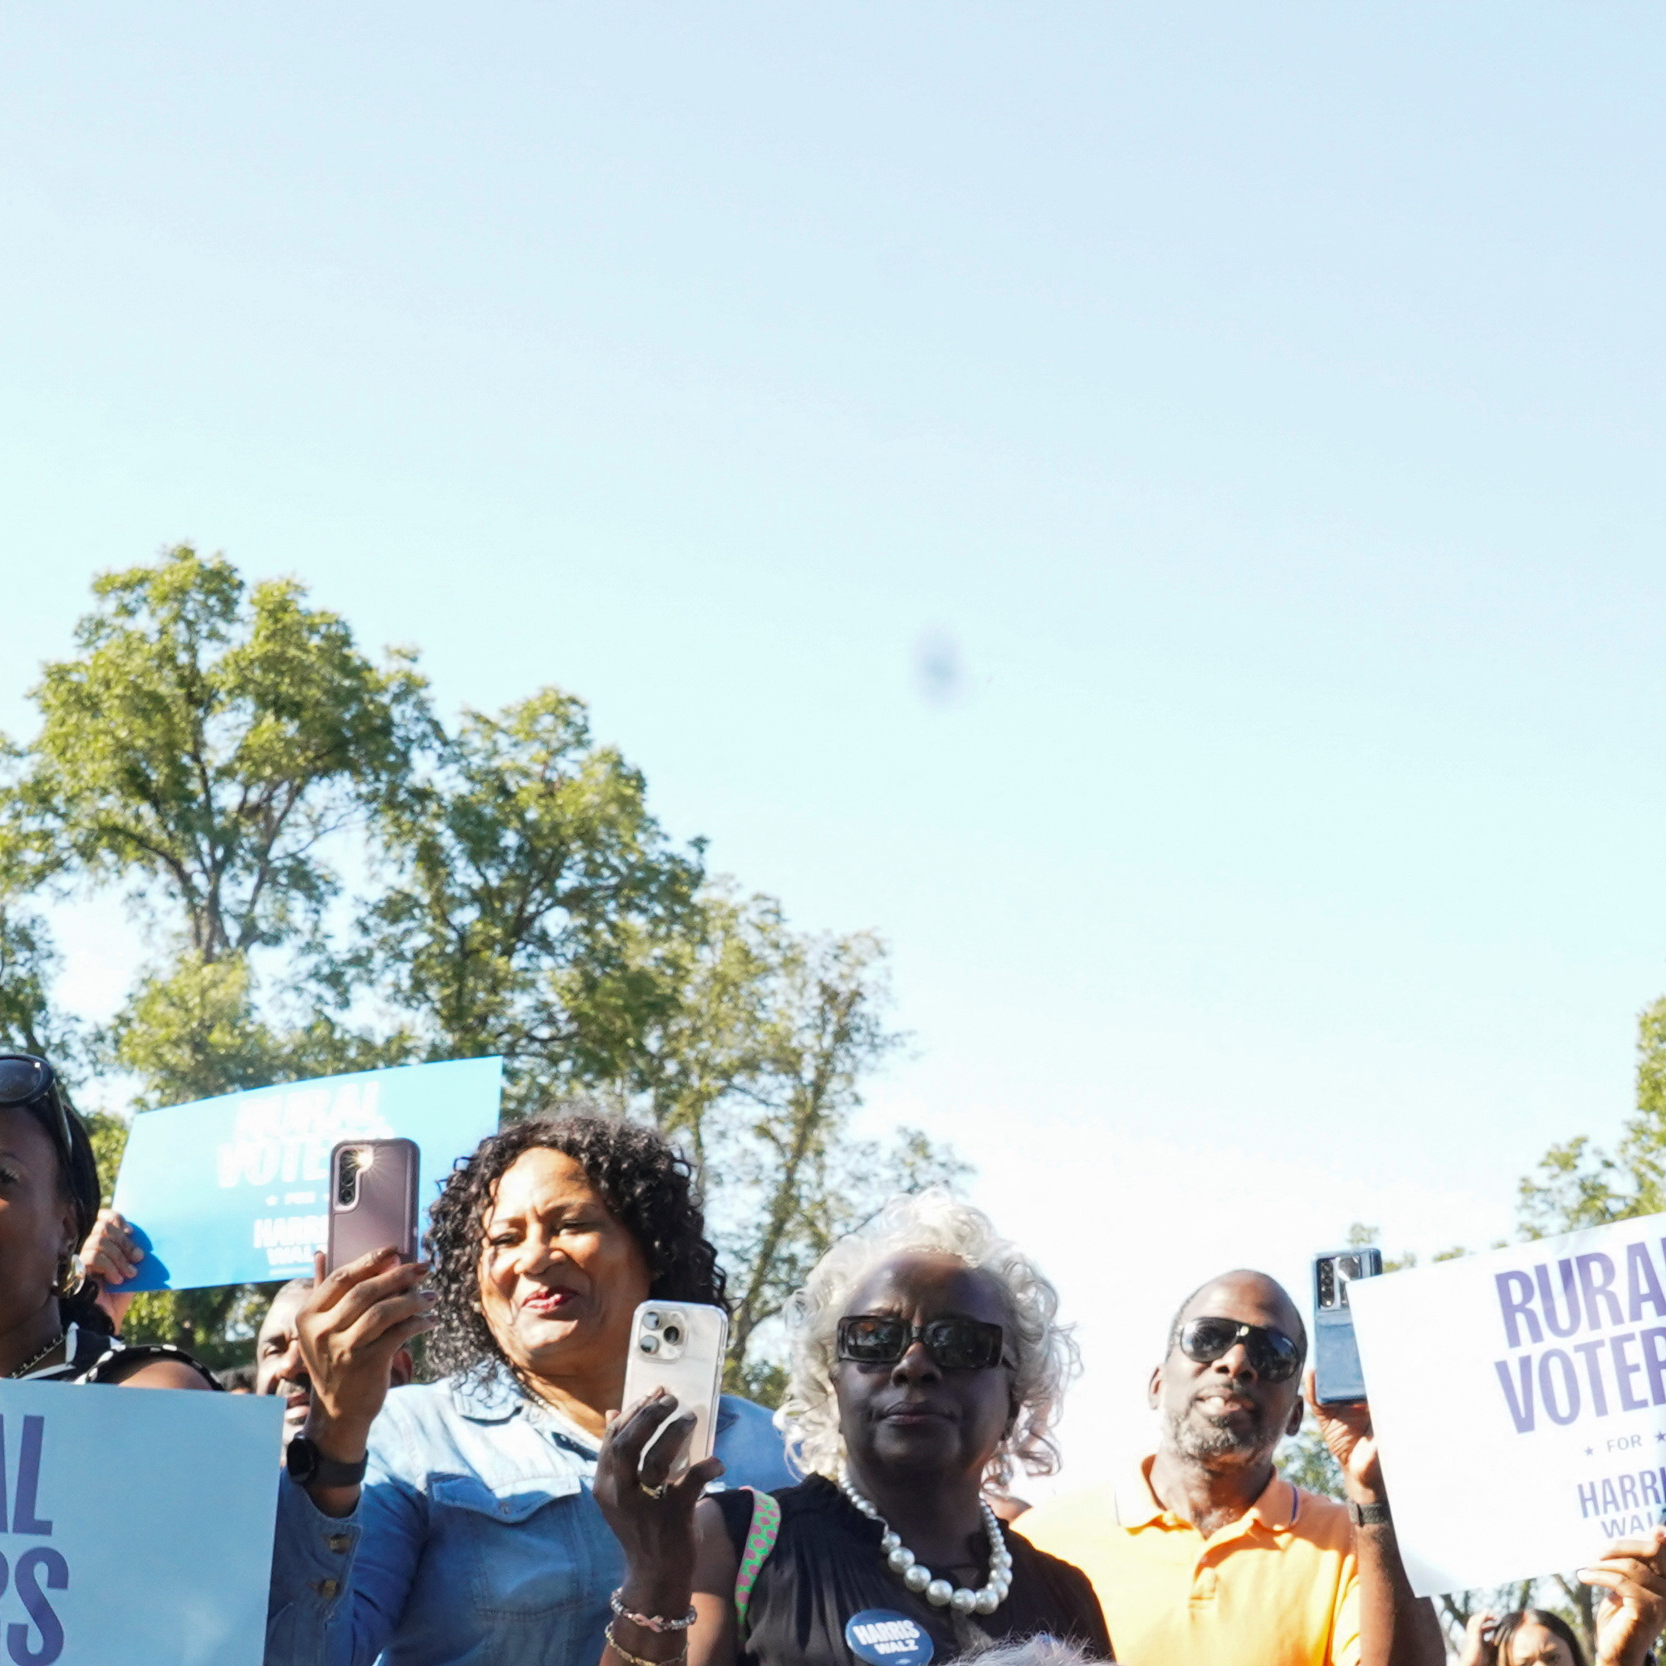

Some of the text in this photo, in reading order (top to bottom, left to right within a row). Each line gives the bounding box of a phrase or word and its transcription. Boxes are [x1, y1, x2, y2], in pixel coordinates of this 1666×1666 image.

[1605, 1433, 1644, 1454] FOR
[852, 1619, 921, 1646] HARRIS
[873, 1638, 920, 1656] WALZ
